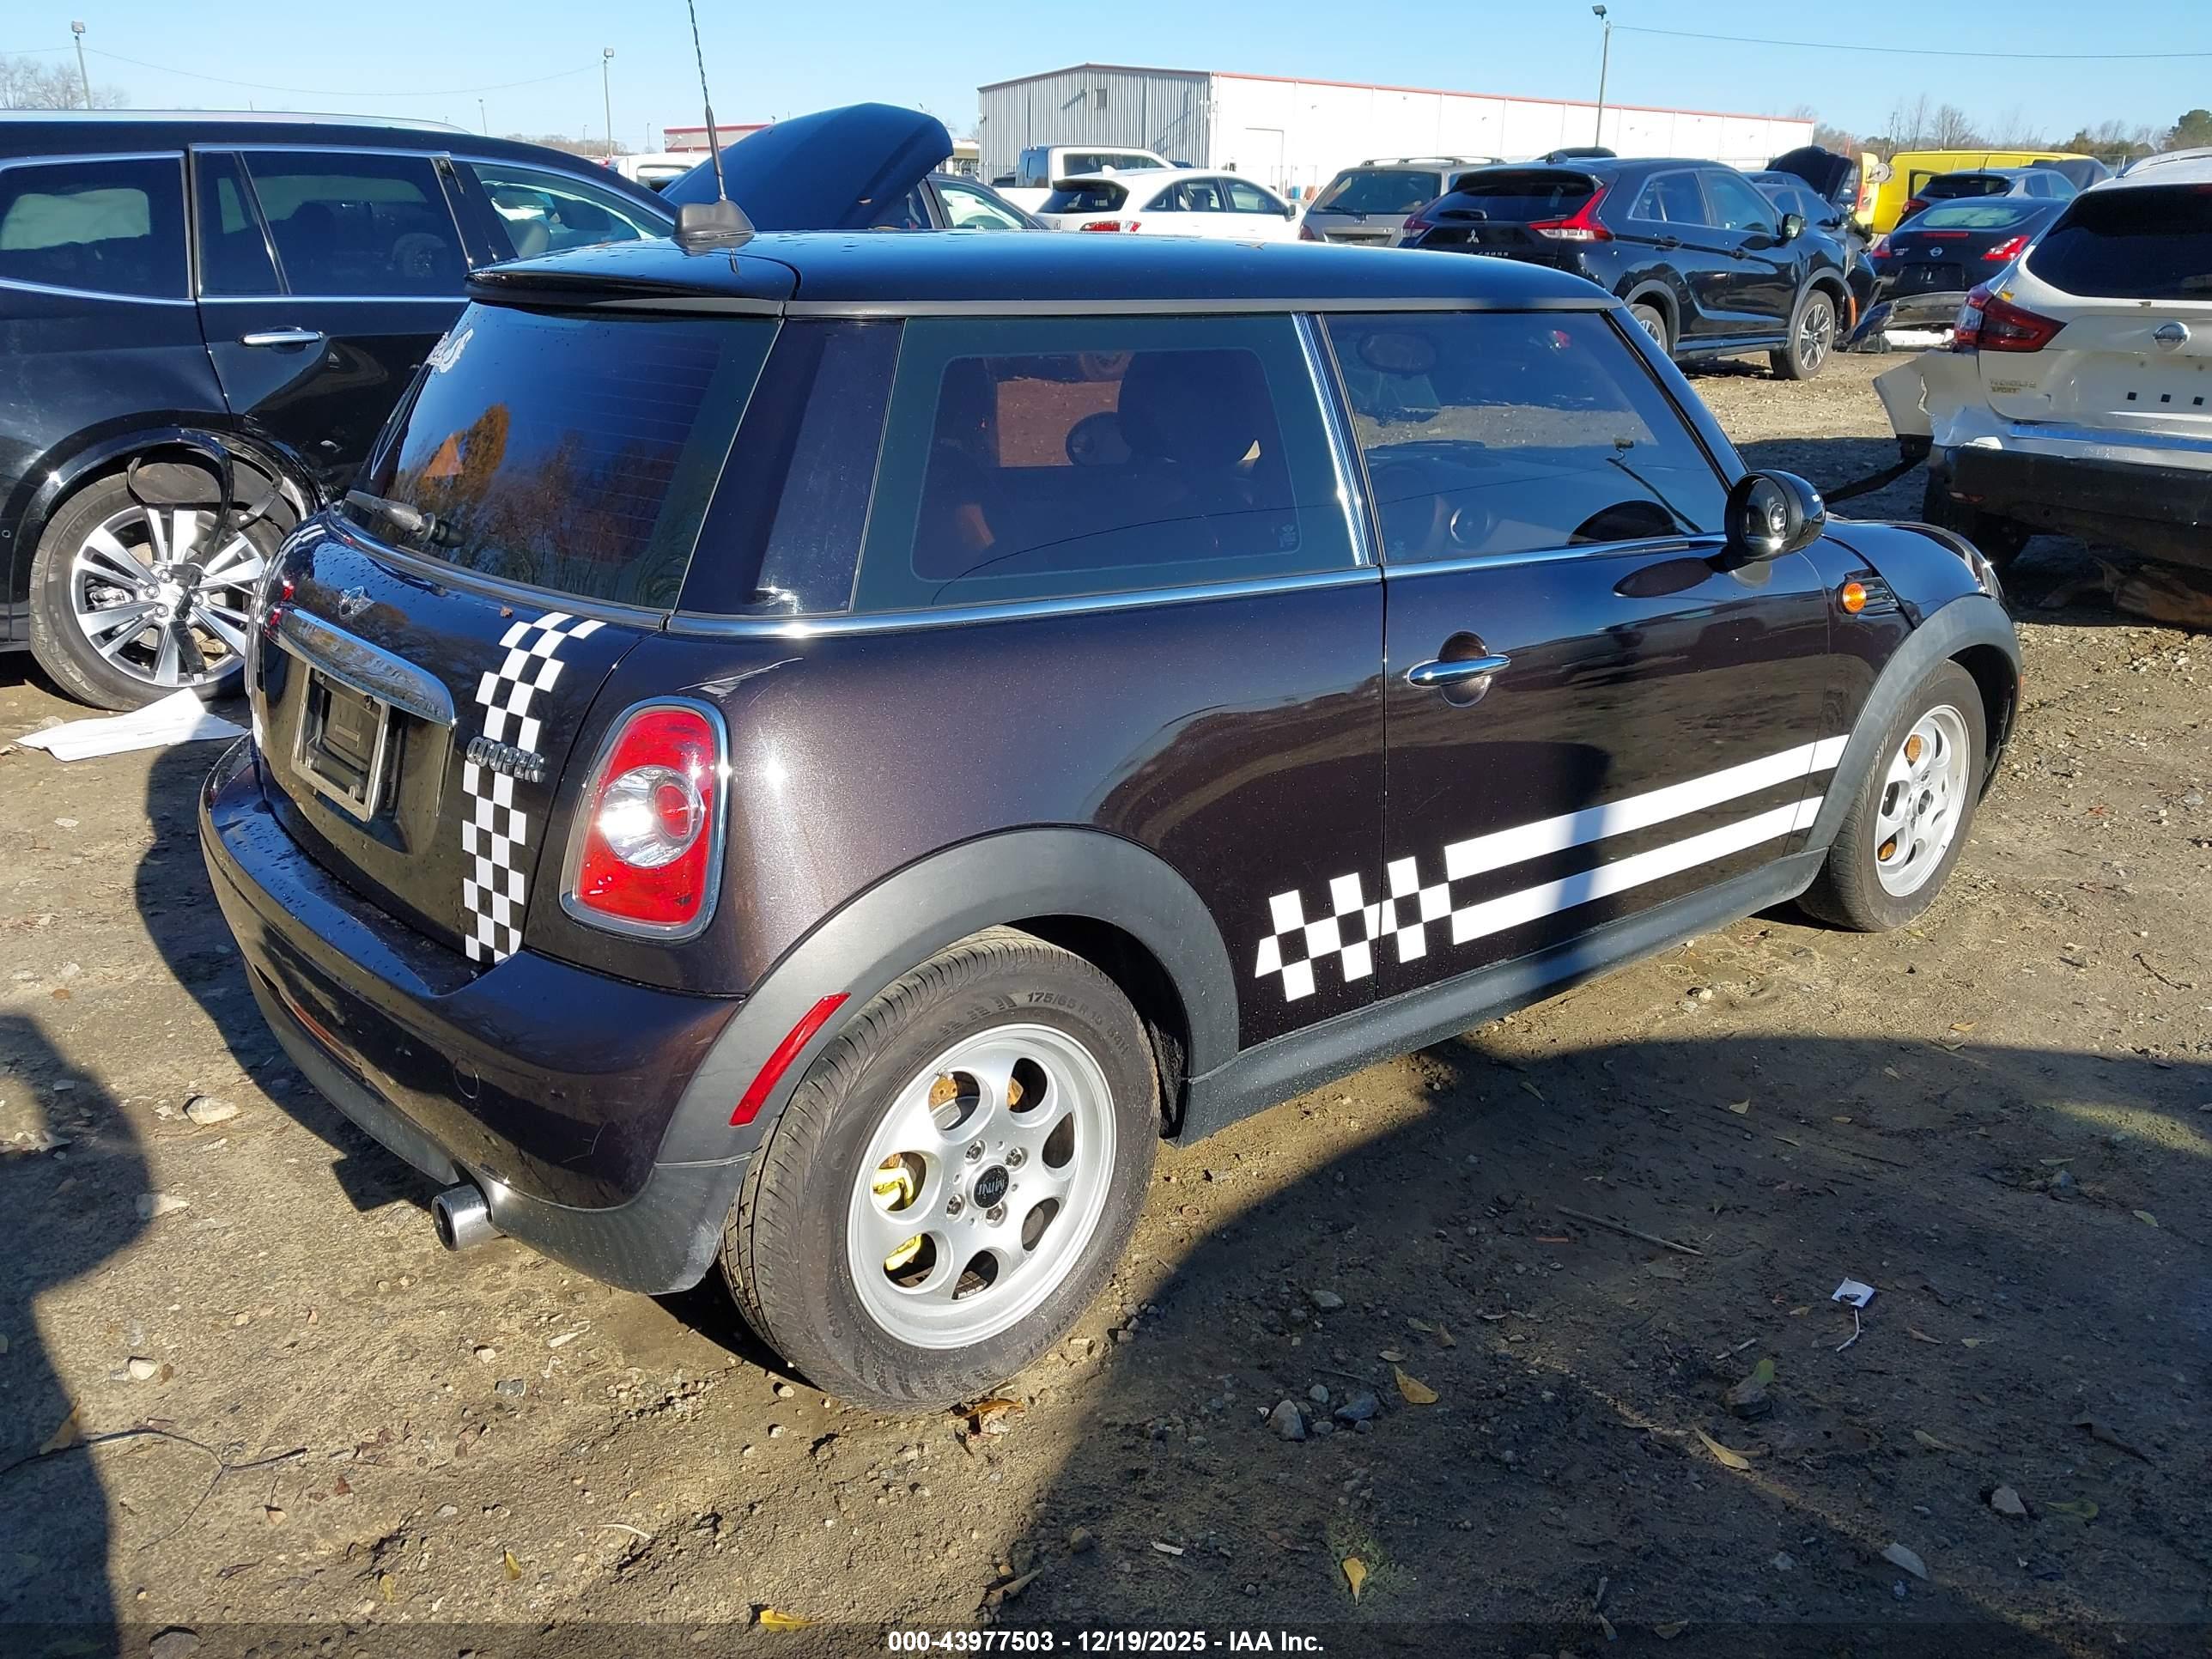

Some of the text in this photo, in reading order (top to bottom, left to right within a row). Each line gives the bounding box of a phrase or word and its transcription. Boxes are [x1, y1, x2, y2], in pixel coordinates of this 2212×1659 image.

[466, 736, 545, 783] COOPER
[1027, 992, 1076, 1010] 175/65
[978, 1178, 1005, 1195] MINI
